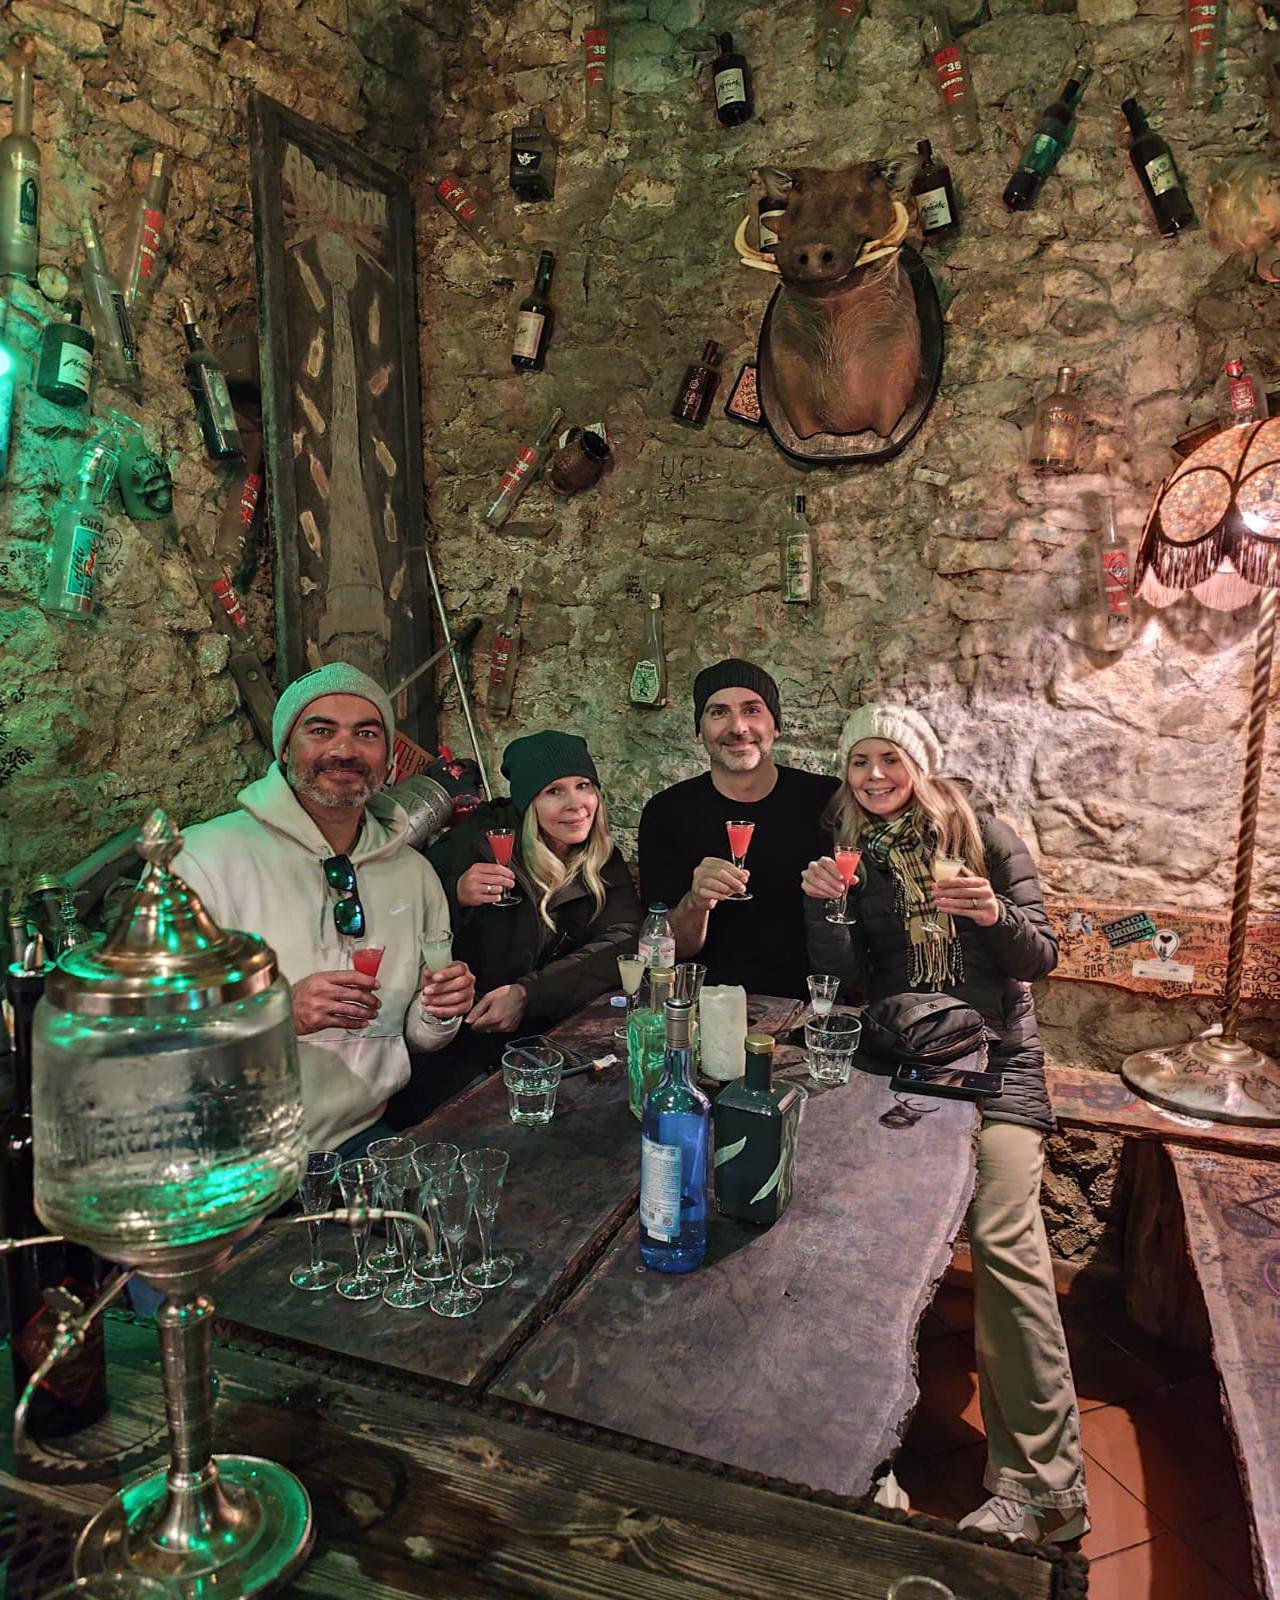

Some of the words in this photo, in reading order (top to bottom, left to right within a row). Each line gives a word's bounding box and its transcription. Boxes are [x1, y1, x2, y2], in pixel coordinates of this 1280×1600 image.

[1201, 5, 1217, 15] 35
[593, 45, 606, 54] 35
[946, 61, 962, 73] 35
[1105, 914, 1145, 933] CANDI
[1084, 963, 1107, 979] SCR
